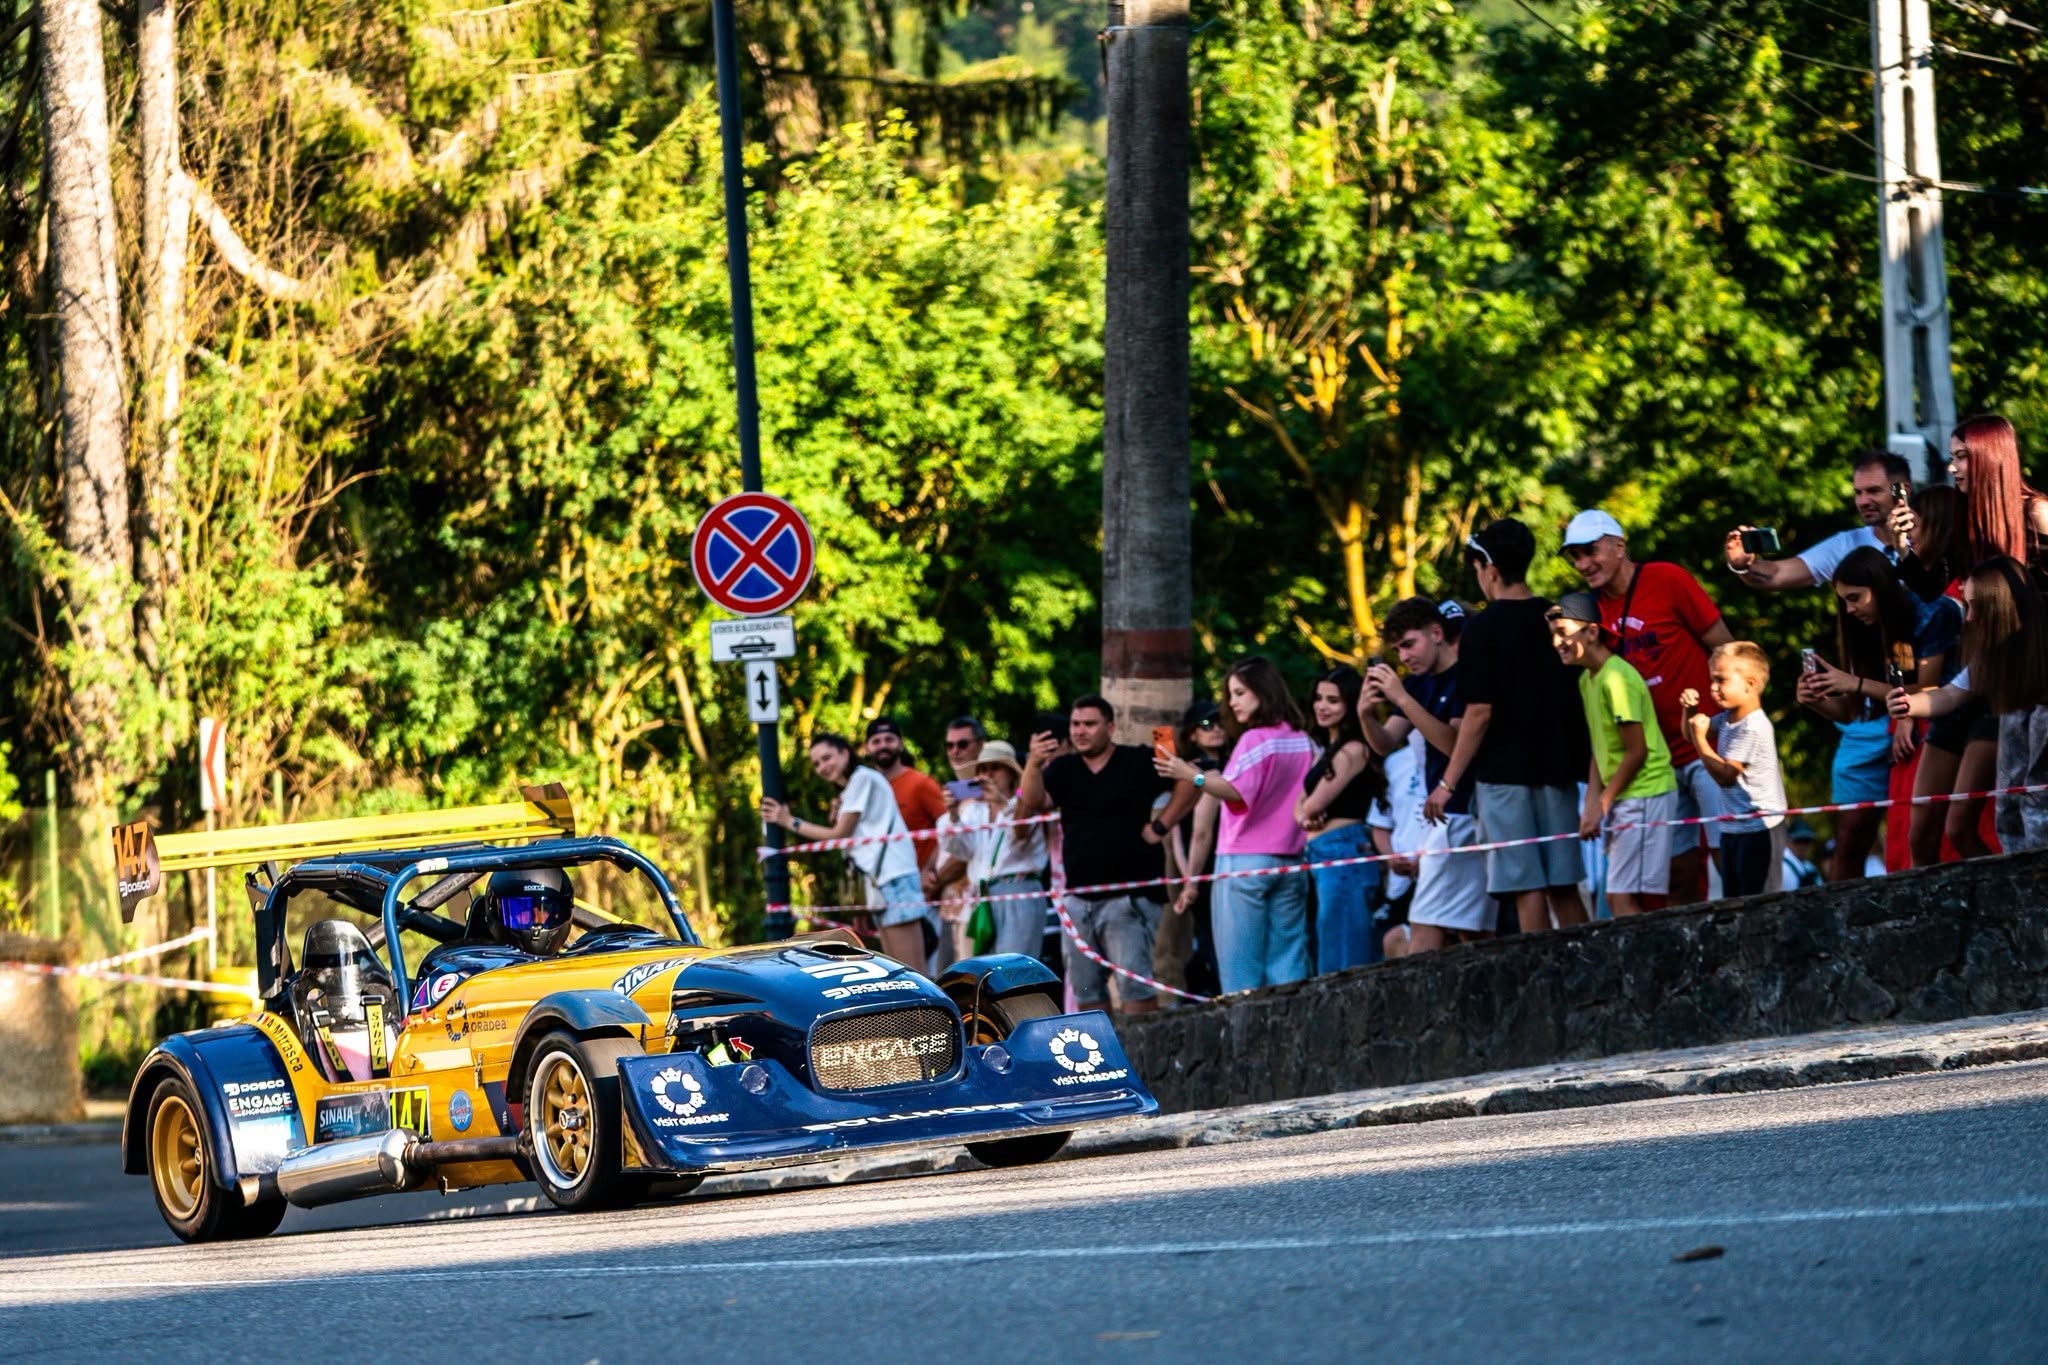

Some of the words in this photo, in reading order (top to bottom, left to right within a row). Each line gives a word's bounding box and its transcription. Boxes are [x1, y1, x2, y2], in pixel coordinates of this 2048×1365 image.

[112, 821, 148, 879] 147
[613, 957, 695, 996] SINAIA
[820, 1033, 948, 1067] ENGAGE
[229, 1092, 293, 1112] ENGAGE
[319, 1106, 354, 1128] SINAIA
[389, 1091, 427, 1136] 147
